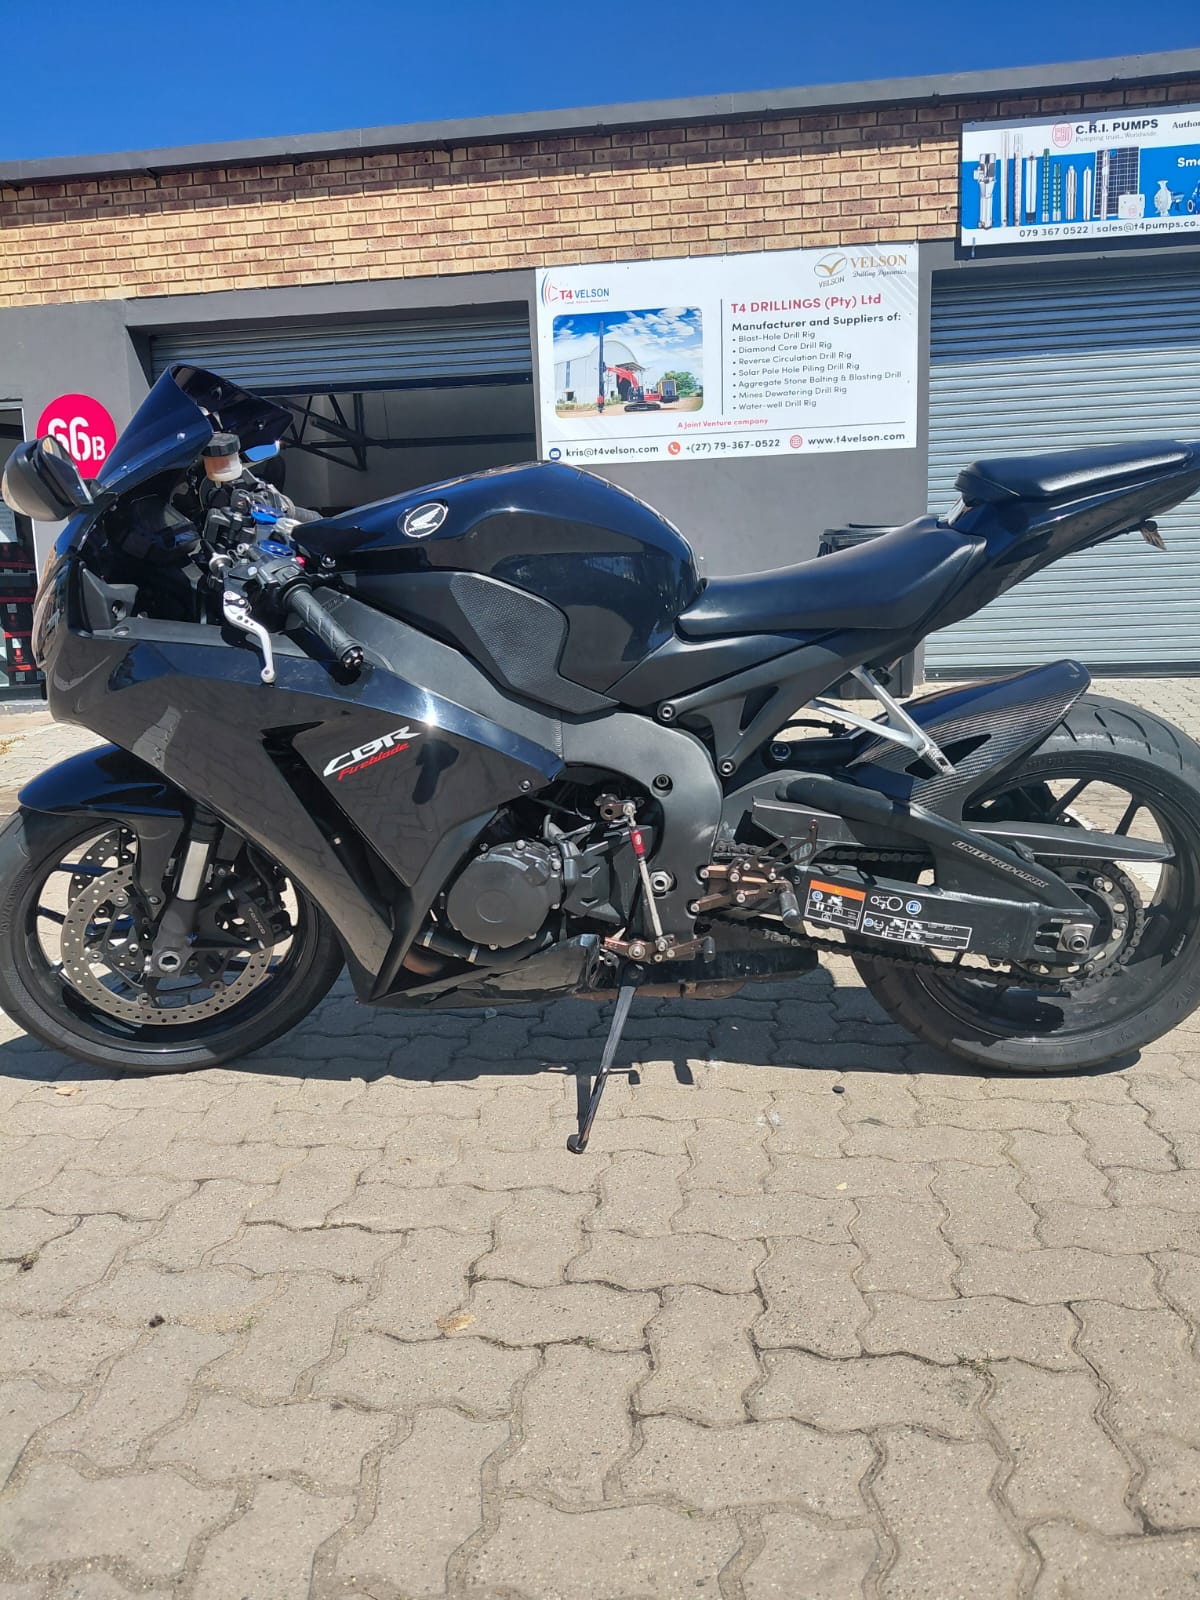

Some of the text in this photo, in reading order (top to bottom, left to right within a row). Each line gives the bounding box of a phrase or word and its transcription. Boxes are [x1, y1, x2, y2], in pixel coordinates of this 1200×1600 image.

[1075, 119, 1159, 135] C.R.I. PUMPS
[1019, 229, 1038, 237] 079
[1042, 228, 1059, 236] 367
[1063, 226, 1089, 235] 0522
[850, 254, 907, 268] VELSON
[819, 276, 845, 288] VELSON
[731, 293, 881, 314] T4 DRILLINGS (Pty) Ltd
[732, 312, 901, 331] Manufacturer and Suppliers of:
[738, 331, 816, 342] Blast-Hole Drill Rig
[738, 341, 833, 354] Diamond Core Drill Rig
[738, 351, 852, 365] Reverse Circulation Drill Rig
[738, 362, 860, 377] Solar Pole Hole Piling Drill Rig
[738, 371, 902, 388] Aggregate Stone Bolting & Blasting Drill
[738, 386, 847, 399] Mines Dewatering Drill Rig
[738, 399, 817, 410] Water-well Drill Rig
[702, 419, 732, 427] Venture
[733, 418, 769, 427] company
[686, 439, 780, 453] +(27) 79-367-0522
[807, 433, 905, 445] www.t4velson.com
[566, 445, 659, 457] kris@t4velson.com
[323, 725, 422, 777] CBR
[337, 742, 410, 781] Fireblade
